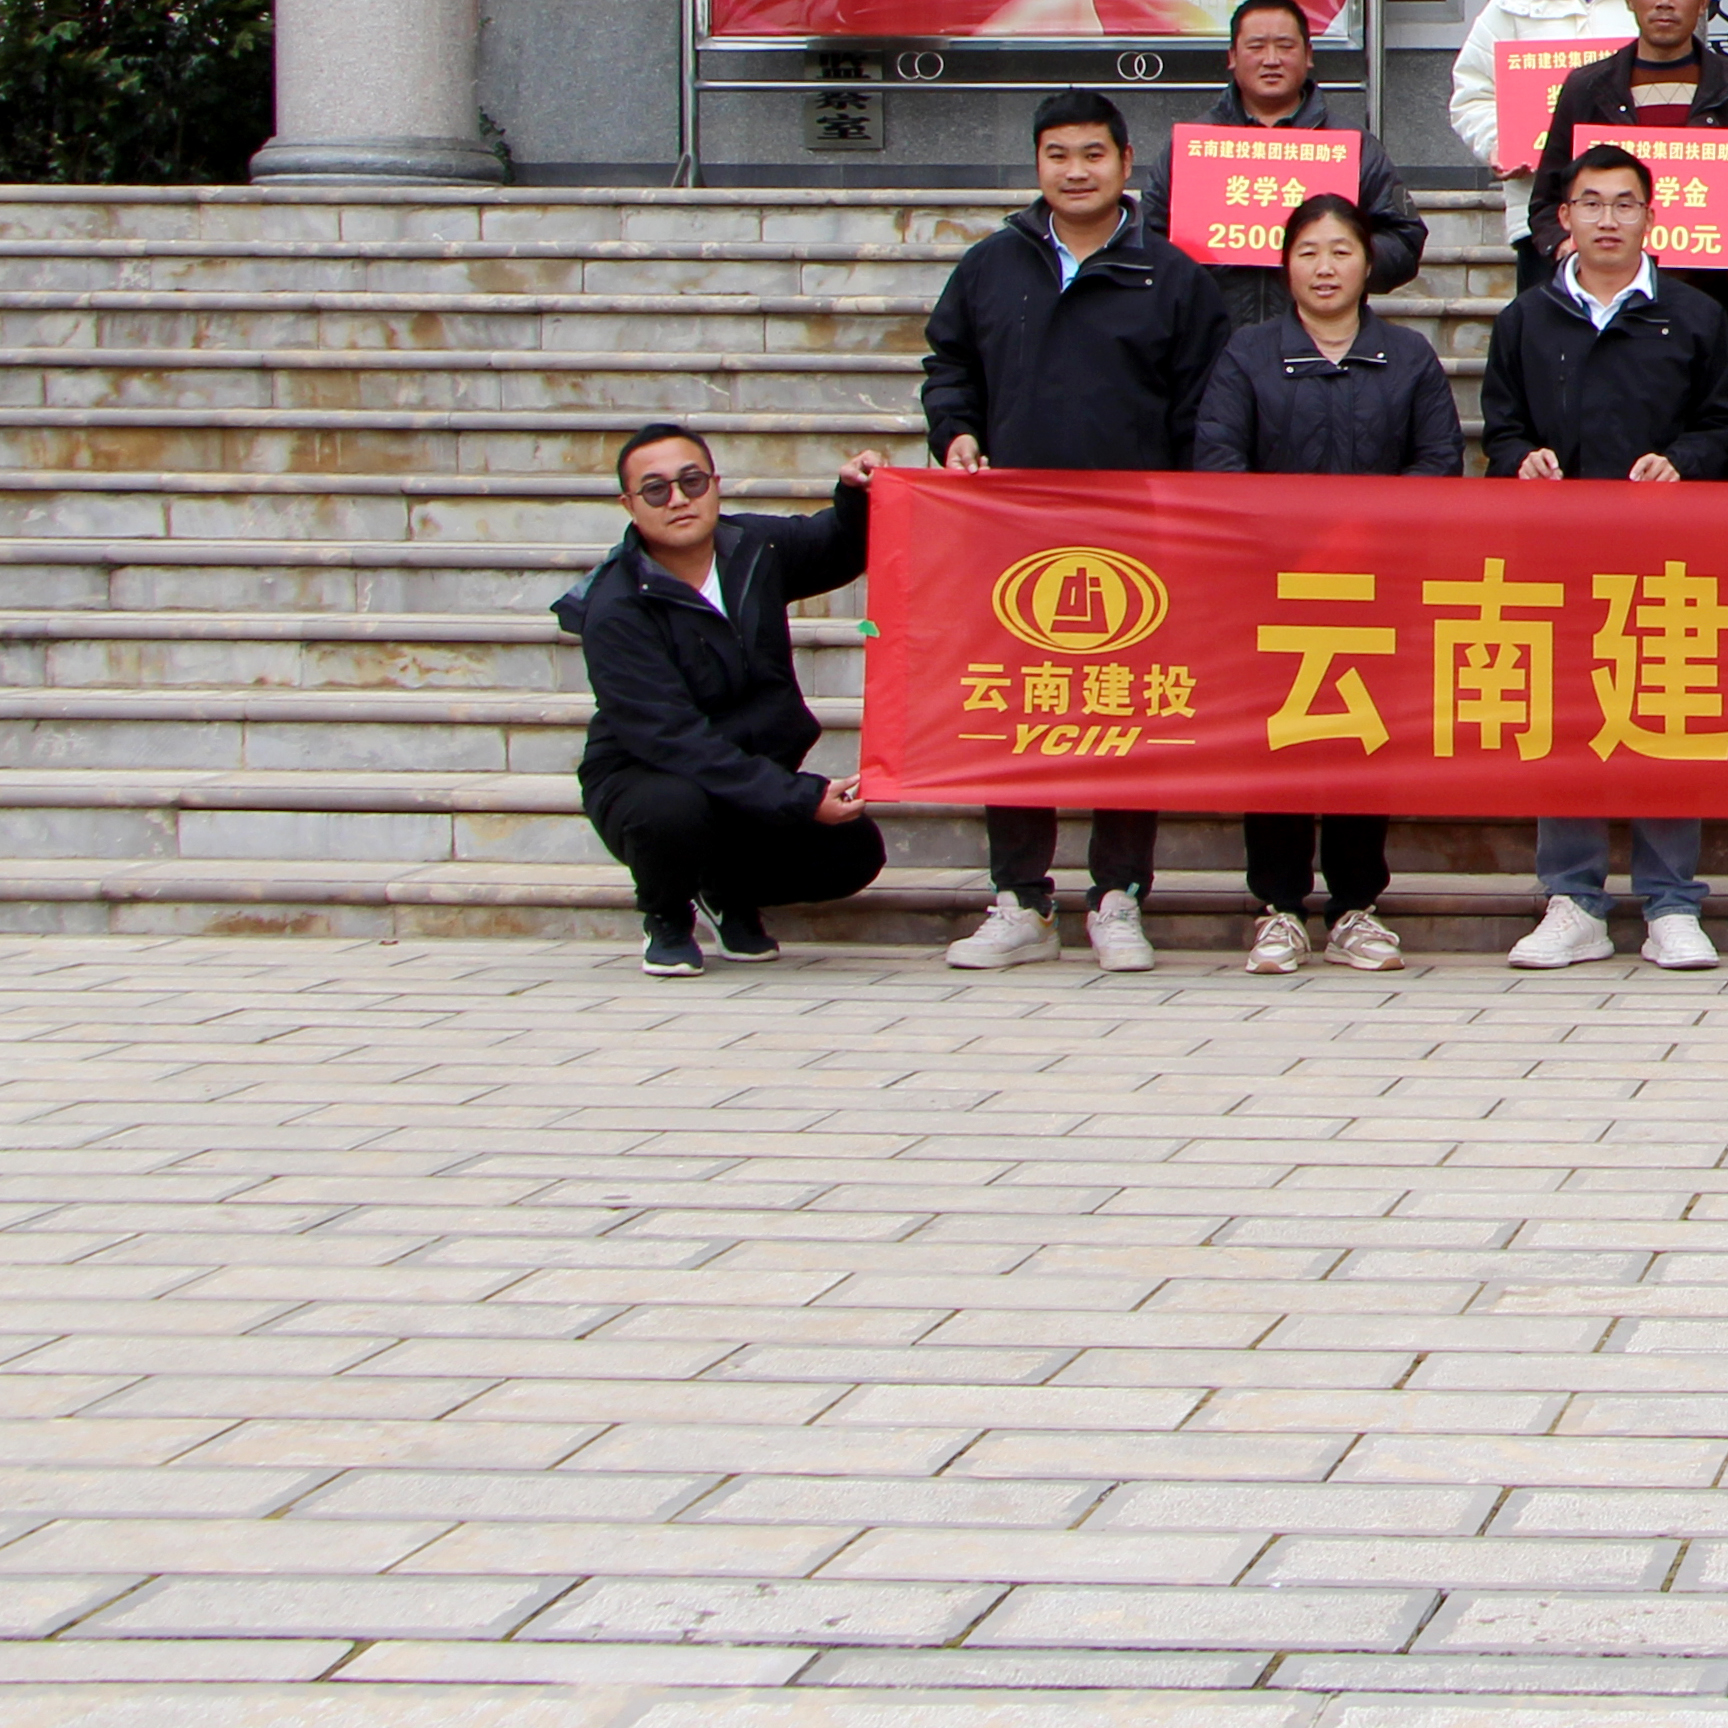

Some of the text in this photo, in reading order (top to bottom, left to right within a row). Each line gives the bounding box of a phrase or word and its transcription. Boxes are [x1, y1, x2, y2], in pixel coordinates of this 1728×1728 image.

[1188, 138, 1347, 163] 云南建投集团扶困助学
[1226, 175, 1306, 208] 奖学金
[960, 661, 1197, 718] 云南建投
[1012, 723, 1142, 757] YCIH
